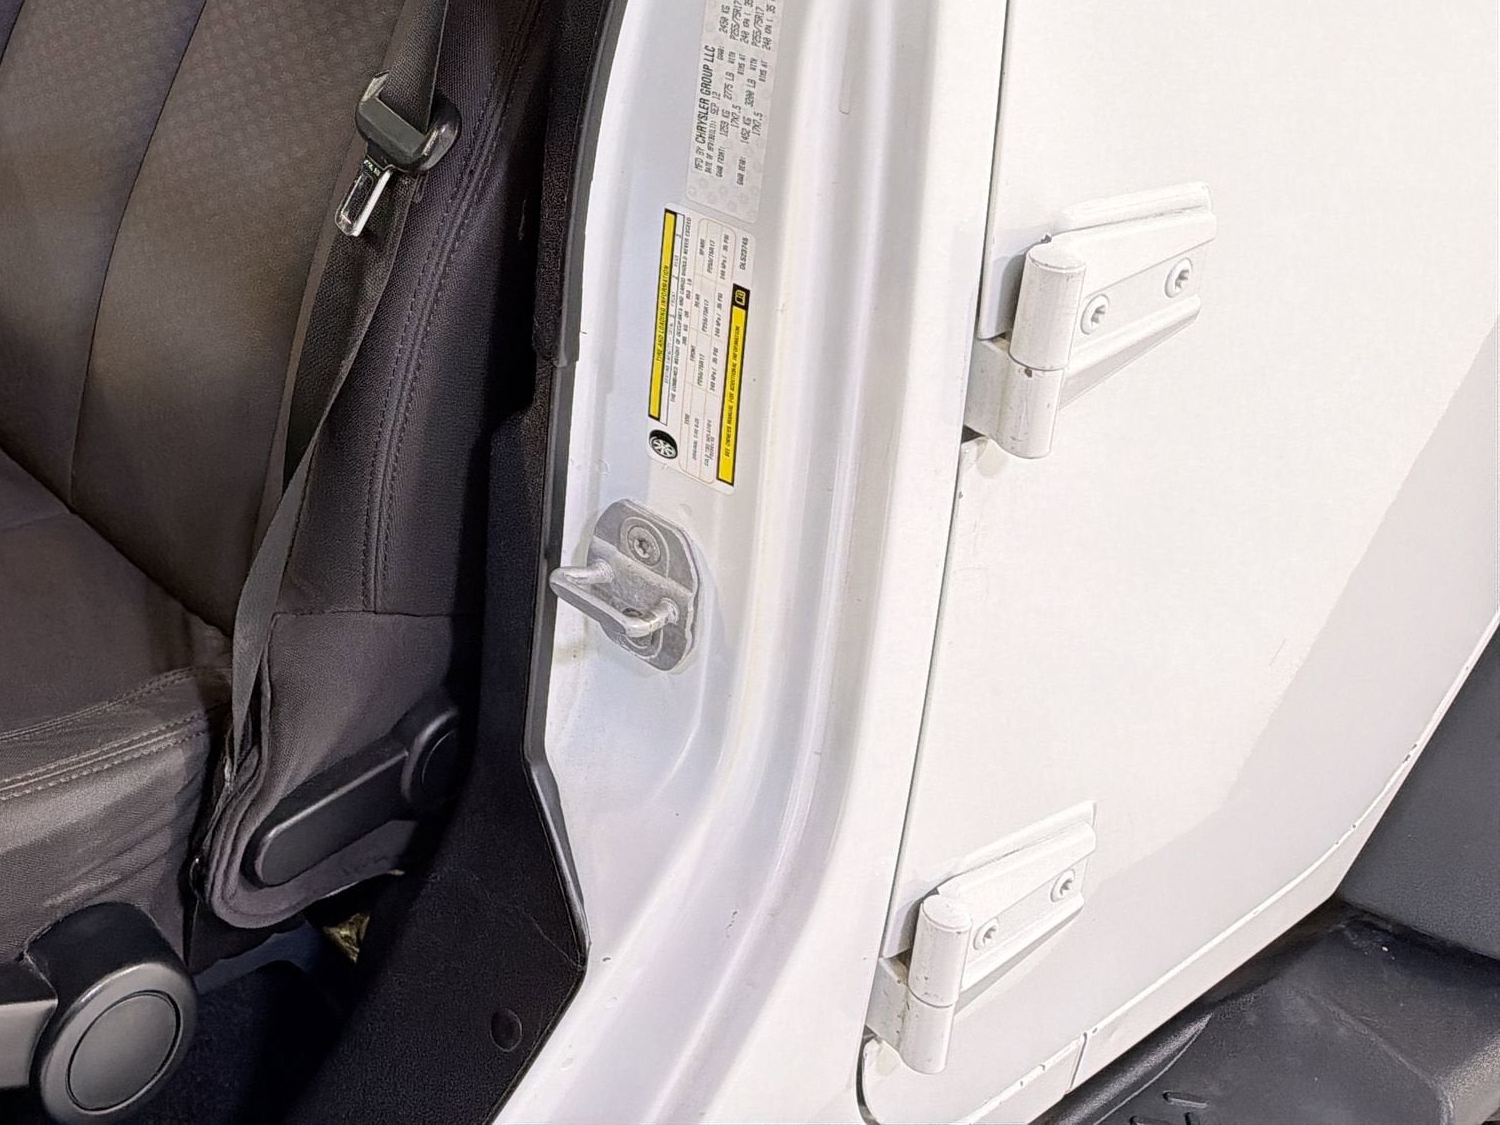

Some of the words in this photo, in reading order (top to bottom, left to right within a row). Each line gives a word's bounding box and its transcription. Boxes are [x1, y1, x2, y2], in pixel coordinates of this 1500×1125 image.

[699, 63, 713, 96] GROUP
[694, 96, 710, 144] CHRYSLER
[660, 263, 669, 306] INFORMATION
